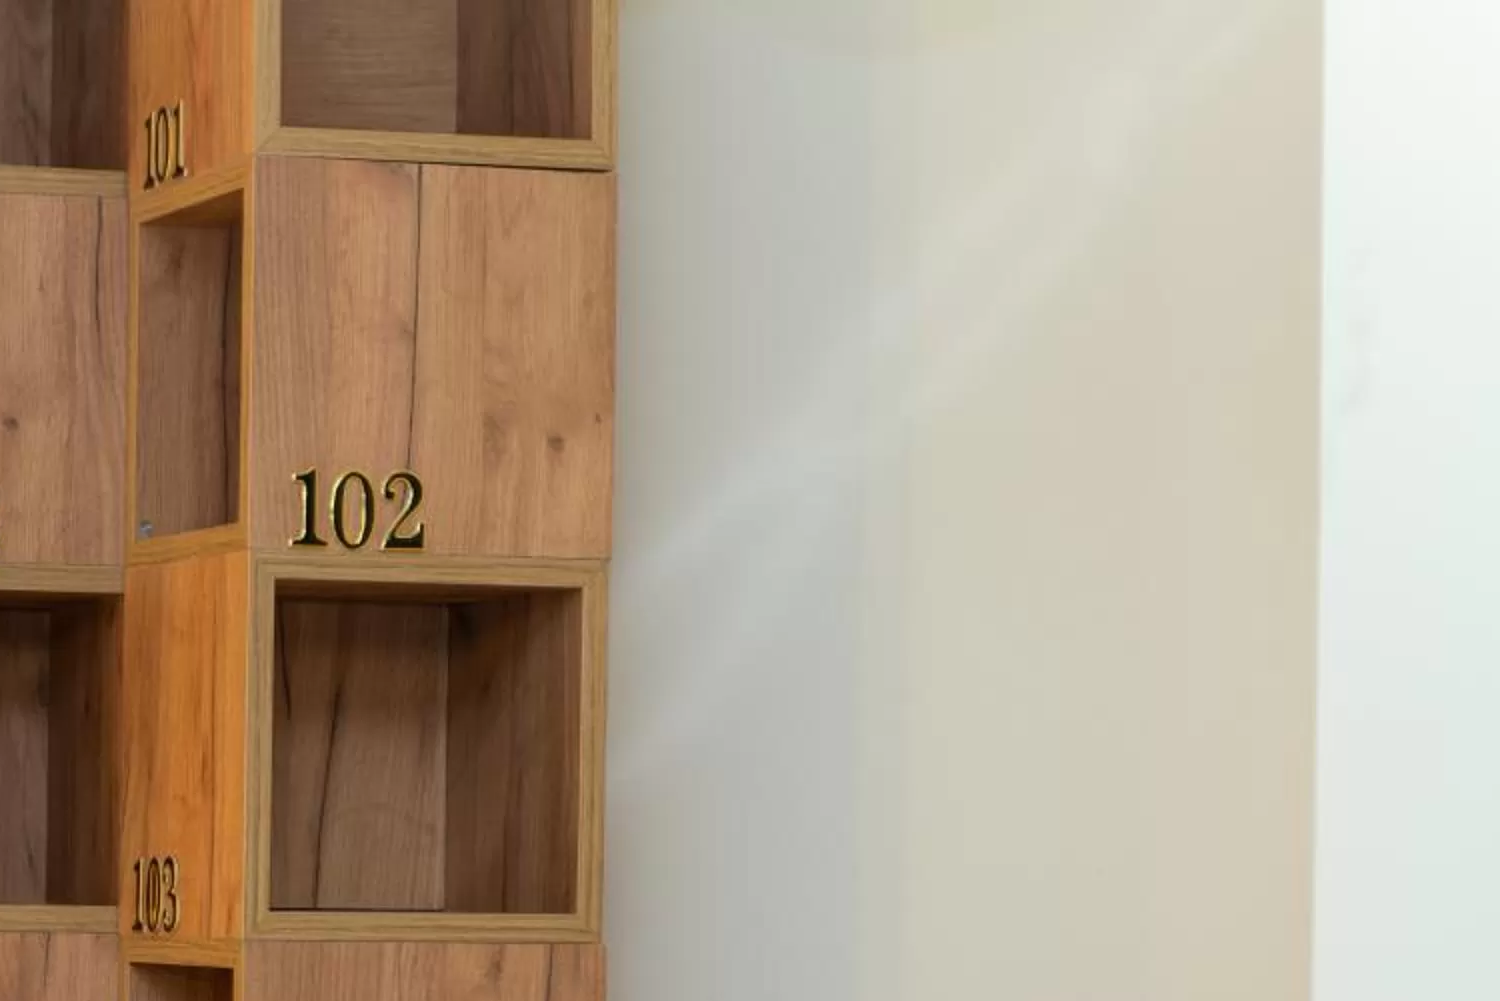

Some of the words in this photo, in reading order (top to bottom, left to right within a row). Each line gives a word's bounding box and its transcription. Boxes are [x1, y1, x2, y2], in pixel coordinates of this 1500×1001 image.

[143, 100, 188, 190] 101
[290, 469, 426, 553] 102
[131, 854, 181, 934] 103
